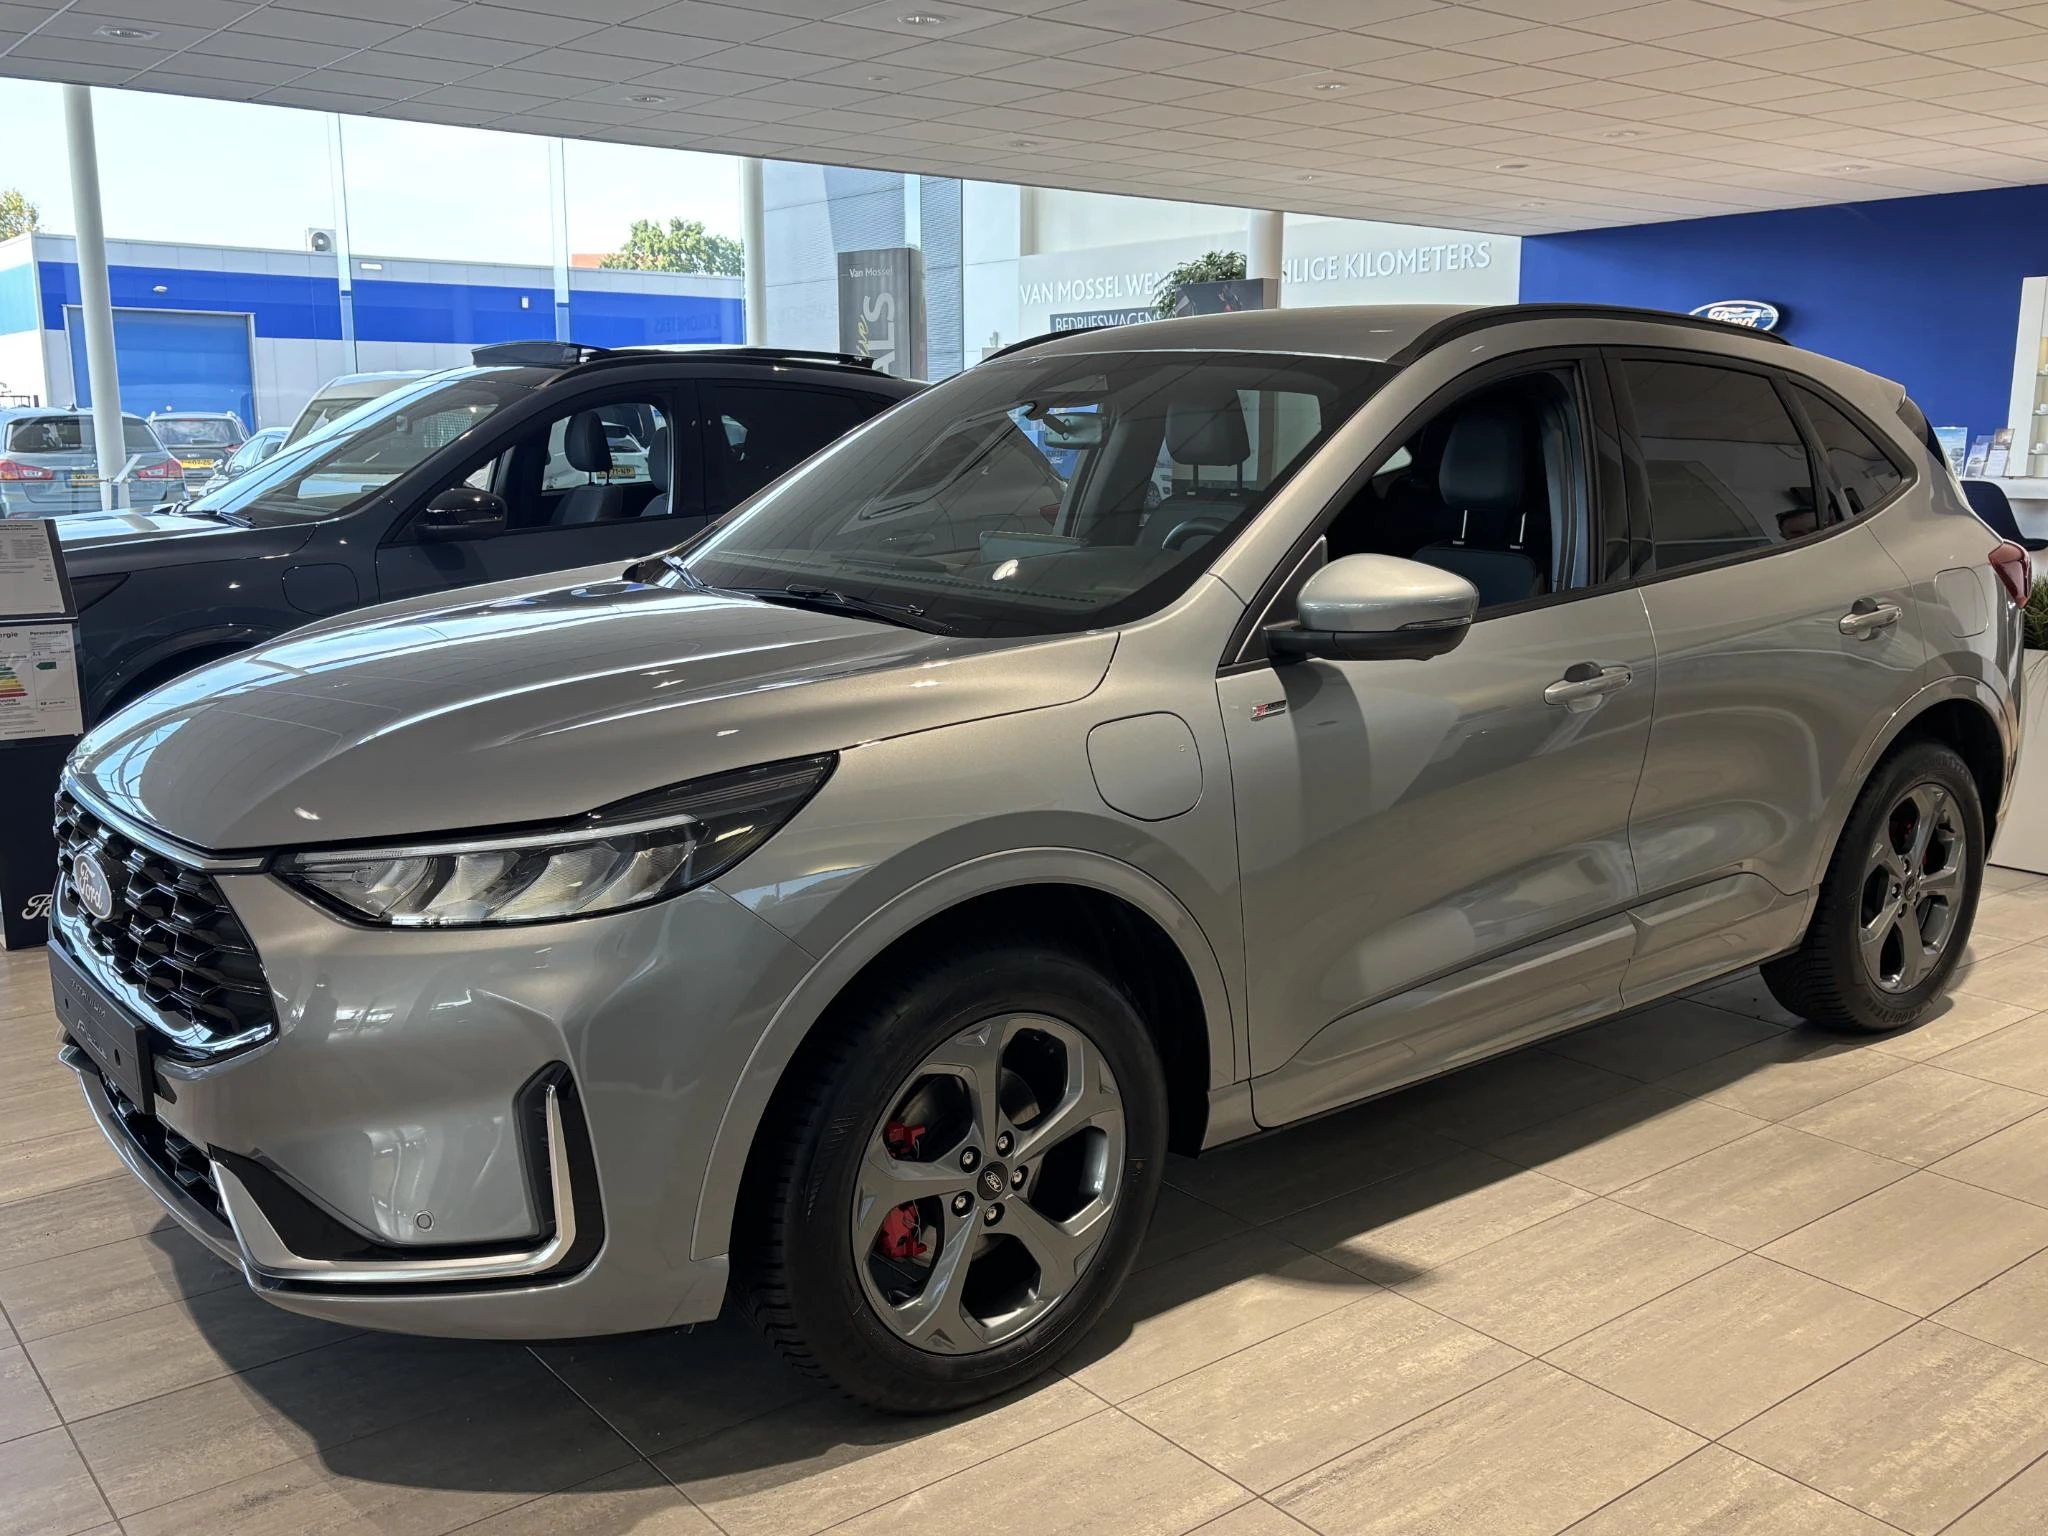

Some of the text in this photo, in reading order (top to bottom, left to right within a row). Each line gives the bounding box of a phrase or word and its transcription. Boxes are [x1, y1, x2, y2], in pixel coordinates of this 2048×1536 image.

[849, 266, 893, 278] Van Mossel
[1020, 282, 1054, 305] VAN
[1058, 274, 1122, 303] MOSSEL
[1282, 255, 1339, 284] ILIGE
[1345, 241, 1491, 279] KILOMETERS
[79, 861, 105, 910] Ford
[21, 893, 52, 920] Fo
